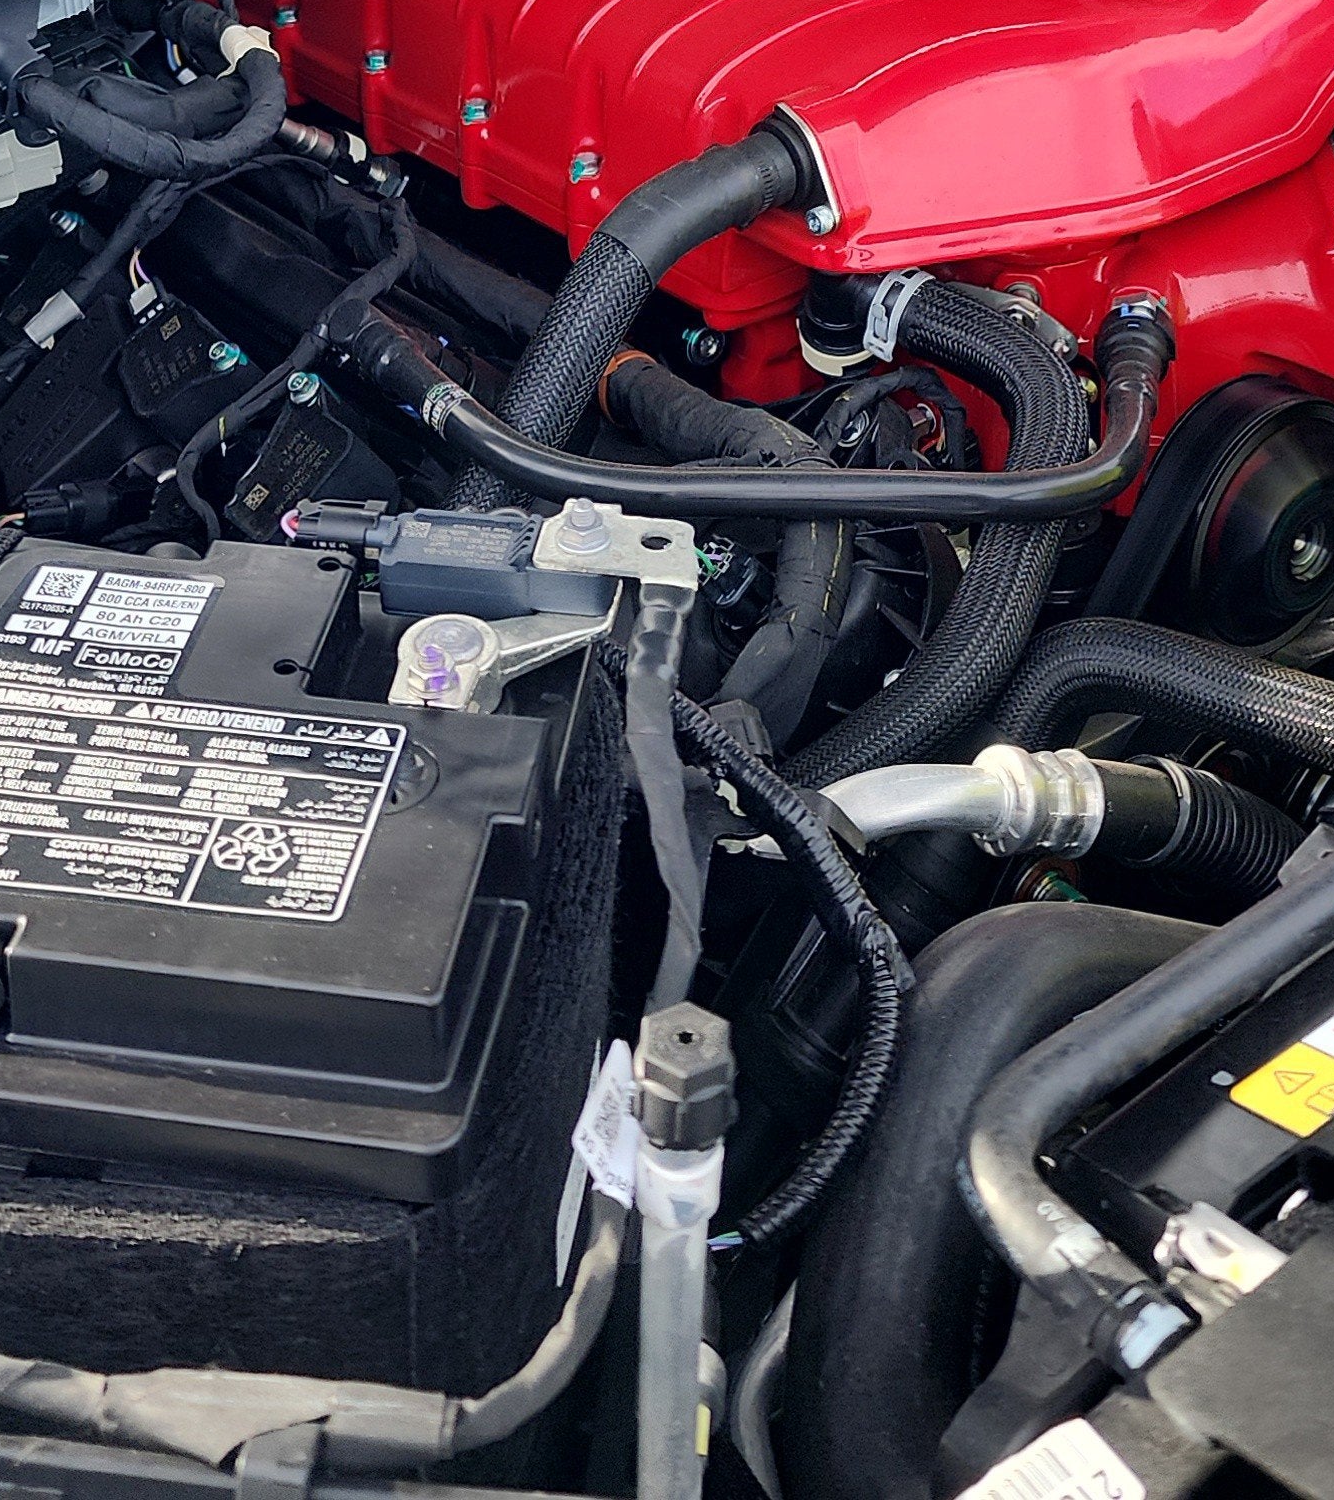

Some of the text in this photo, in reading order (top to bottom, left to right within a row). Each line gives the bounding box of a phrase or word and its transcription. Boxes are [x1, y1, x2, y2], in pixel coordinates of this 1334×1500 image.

[98, 594, 199, 609] 800 CCA (SAE/EN)
[20, 620, 54, 629] 12V
[95, 612, 181, 625] 80 Ah C20
[82, 628, 178, 644] AGM/VRLA
[28, 638, 76, 655] MF
[82, 649, 174, 669] FoMoCo
[16, 673, 69, 686] Company,
[150, 705, 286, 732] PELIGRO/VENENO
[84, 809, 107, 820] LEA
[106, 812, 128, 822] LAS
[49, 838, 189, 862] CONTRA DERRAMES
